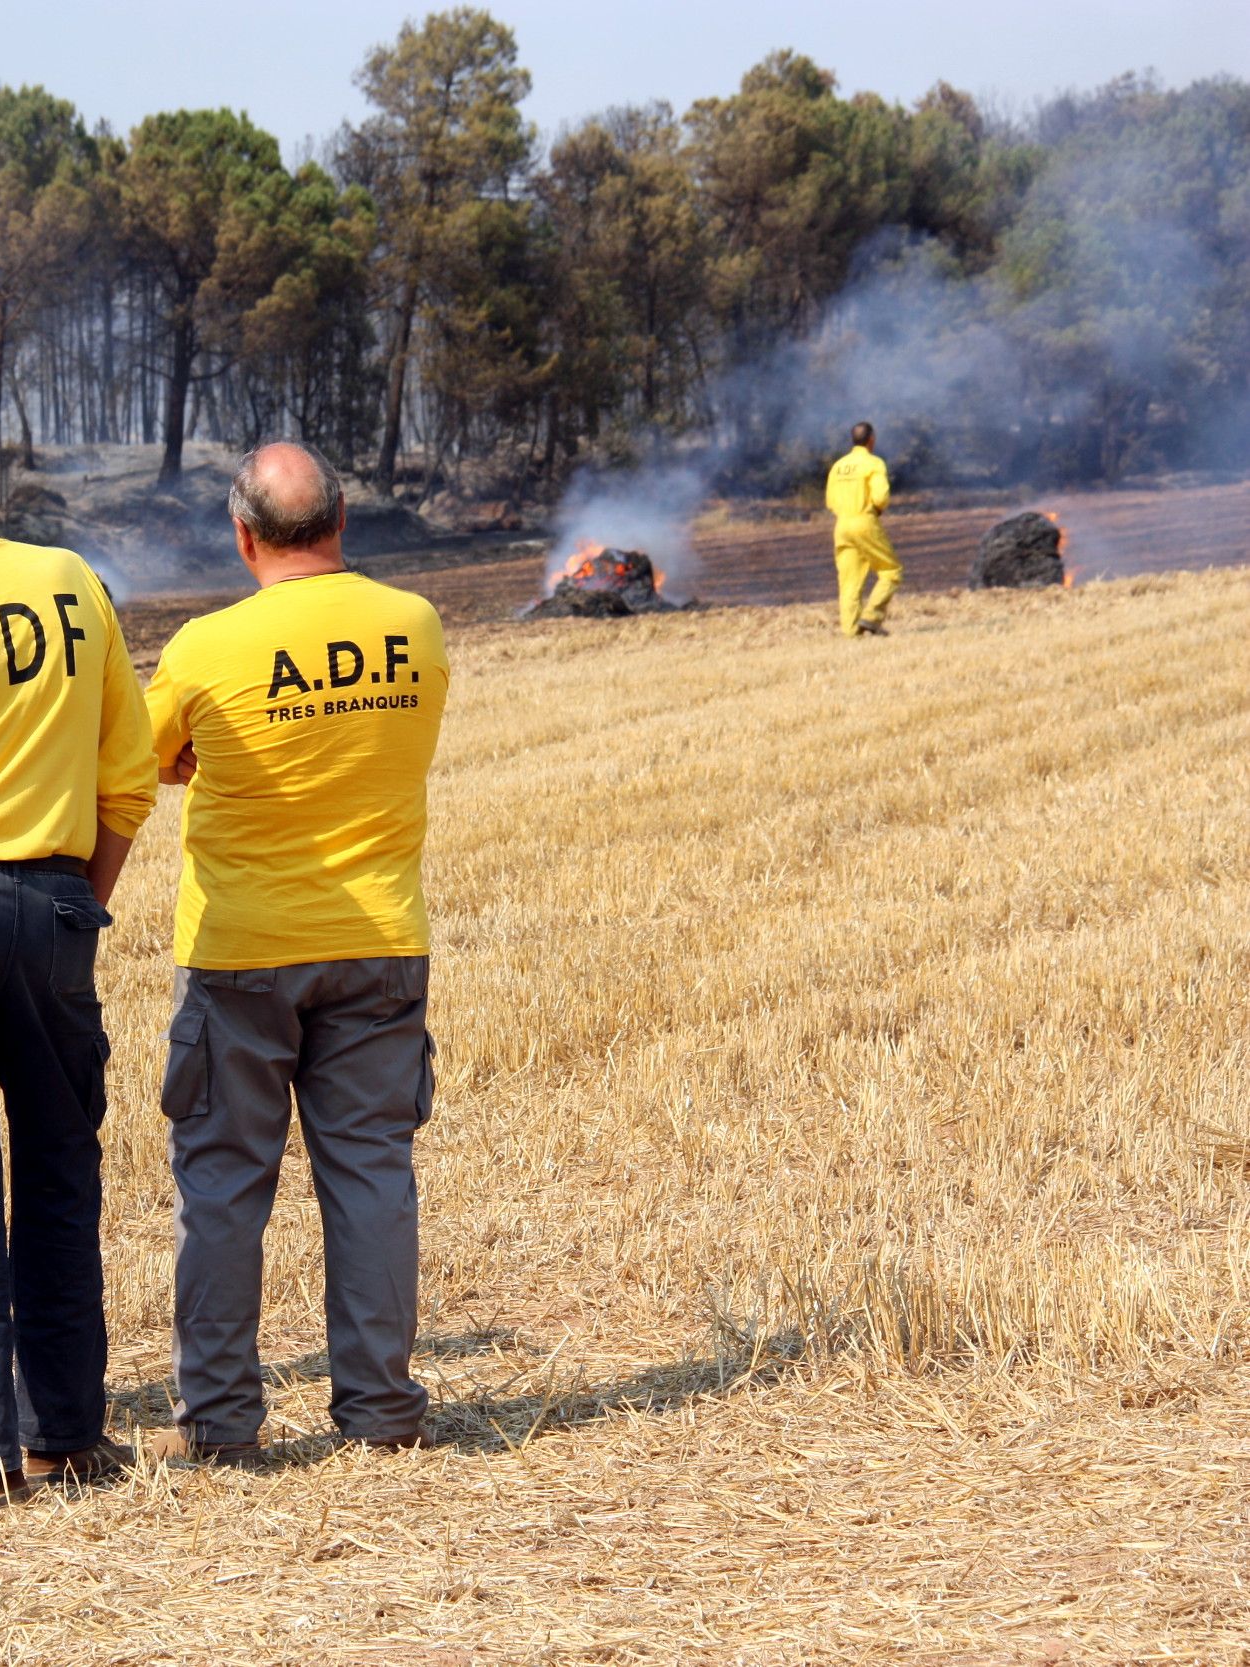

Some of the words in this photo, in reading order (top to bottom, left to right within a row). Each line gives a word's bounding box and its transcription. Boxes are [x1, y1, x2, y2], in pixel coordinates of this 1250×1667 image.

[266, 635, 419, 699] A.D.F.
[266, 704, 316, 723] TRES
[323, 694, 419, 715] BRANQUES
